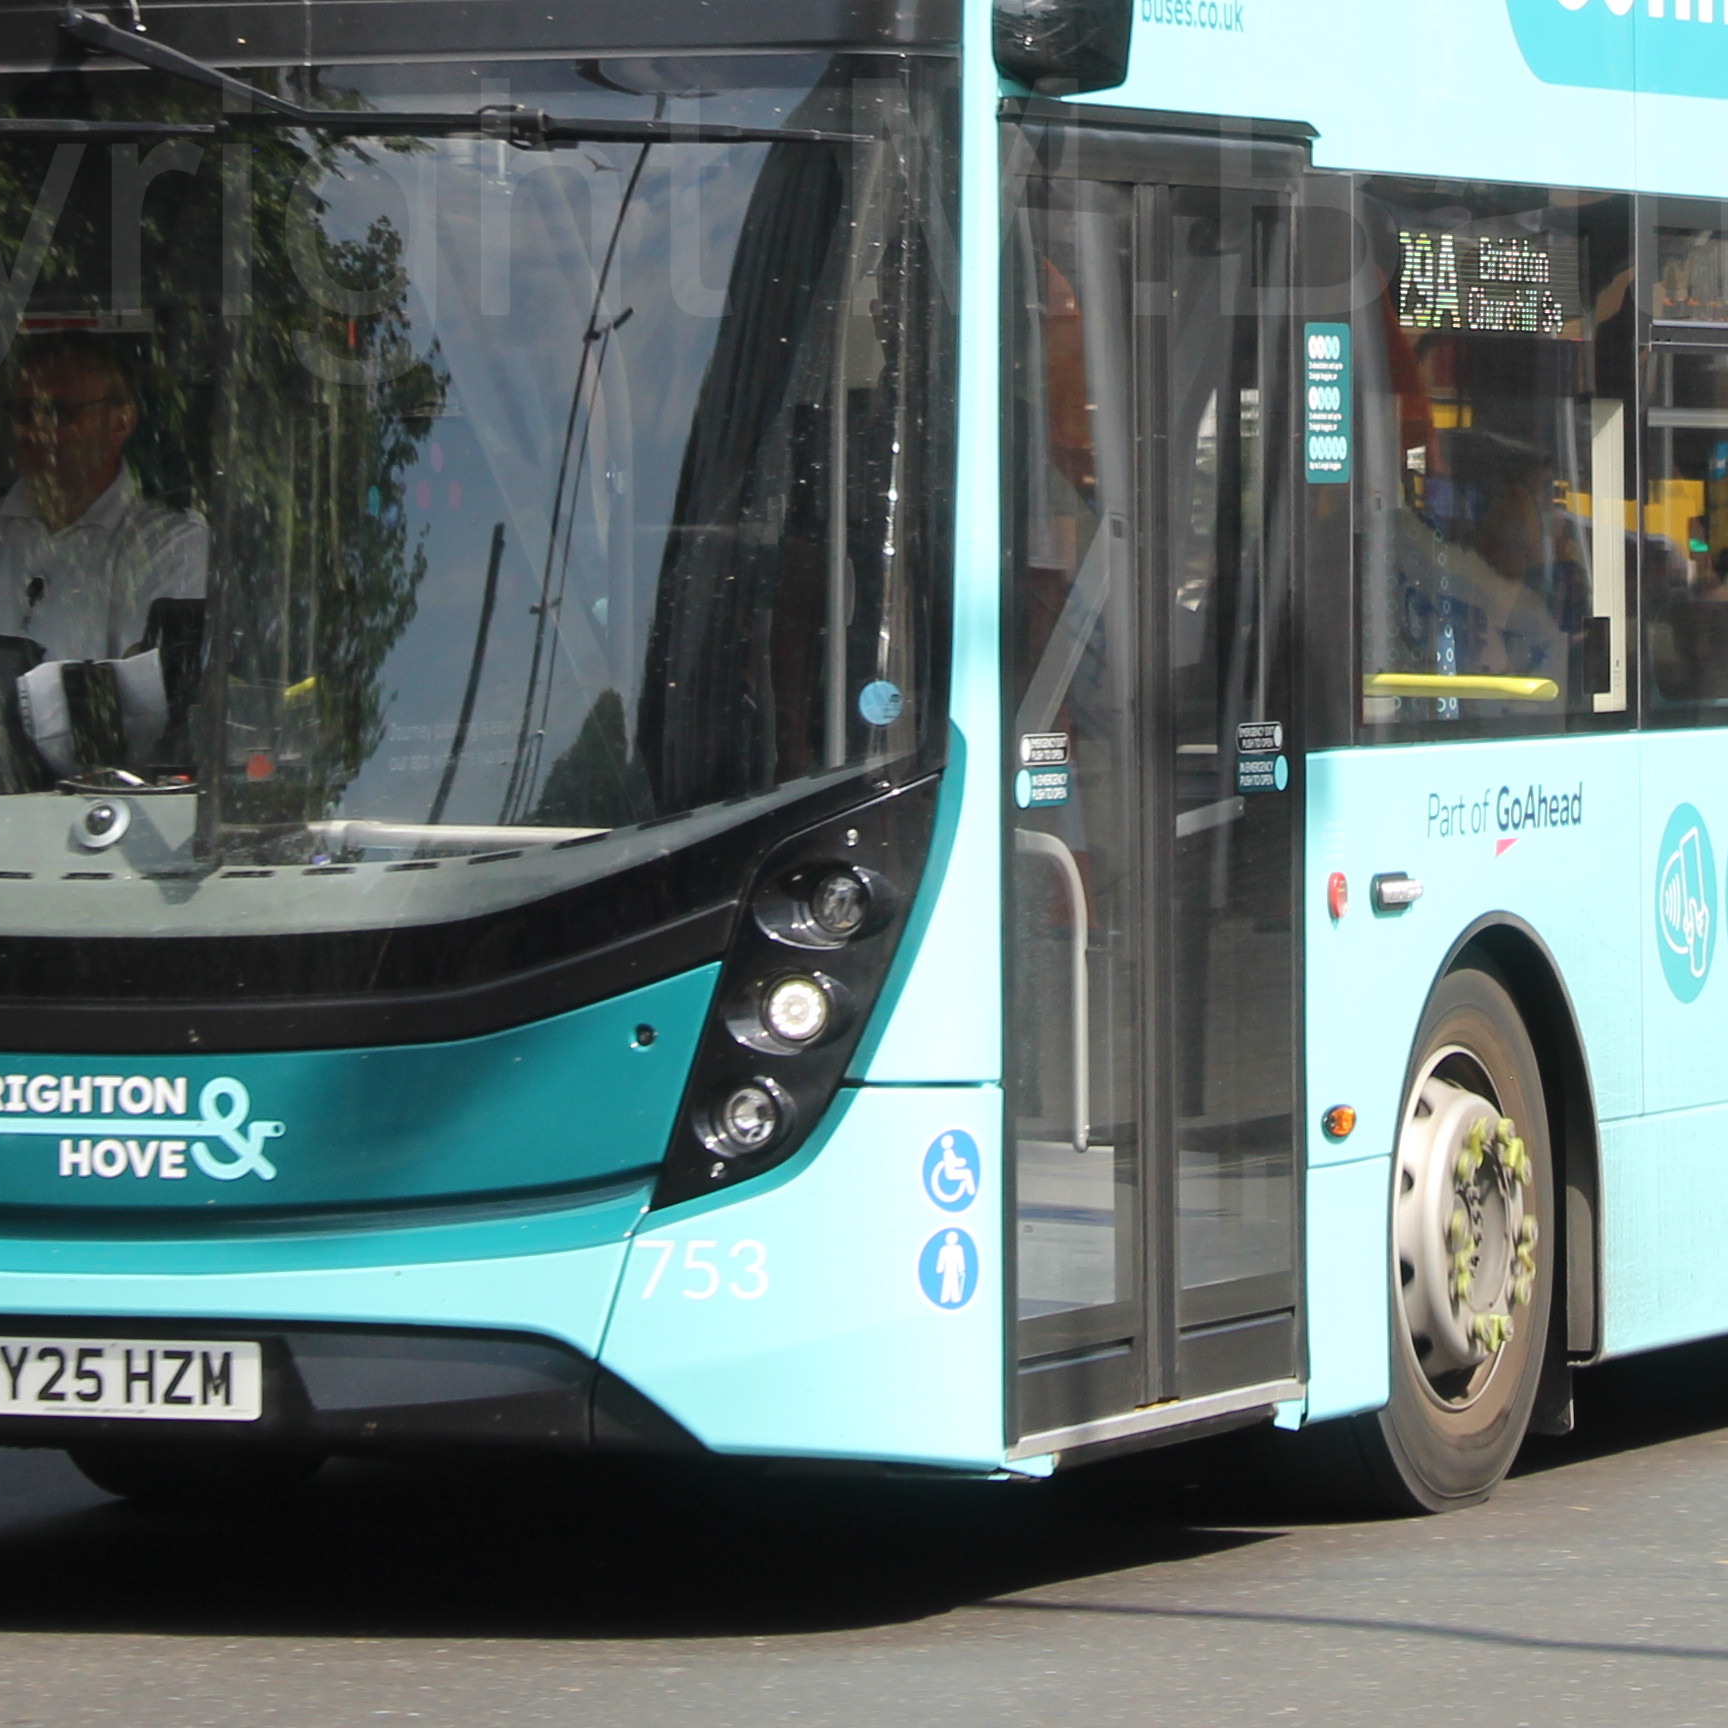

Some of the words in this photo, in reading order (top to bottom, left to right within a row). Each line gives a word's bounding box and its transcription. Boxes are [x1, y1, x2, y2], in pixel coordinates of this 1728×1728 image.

[1427, 792, 1466, 839] Part
[1471, 788, 1492, 835] of
[1495, 780, 1583, 832] GoAhead
[58, 1138, 188, 1180] HOVE
[633, 1238, 770, 1301] 753
[124, 1348, 235, 1406] HZM
